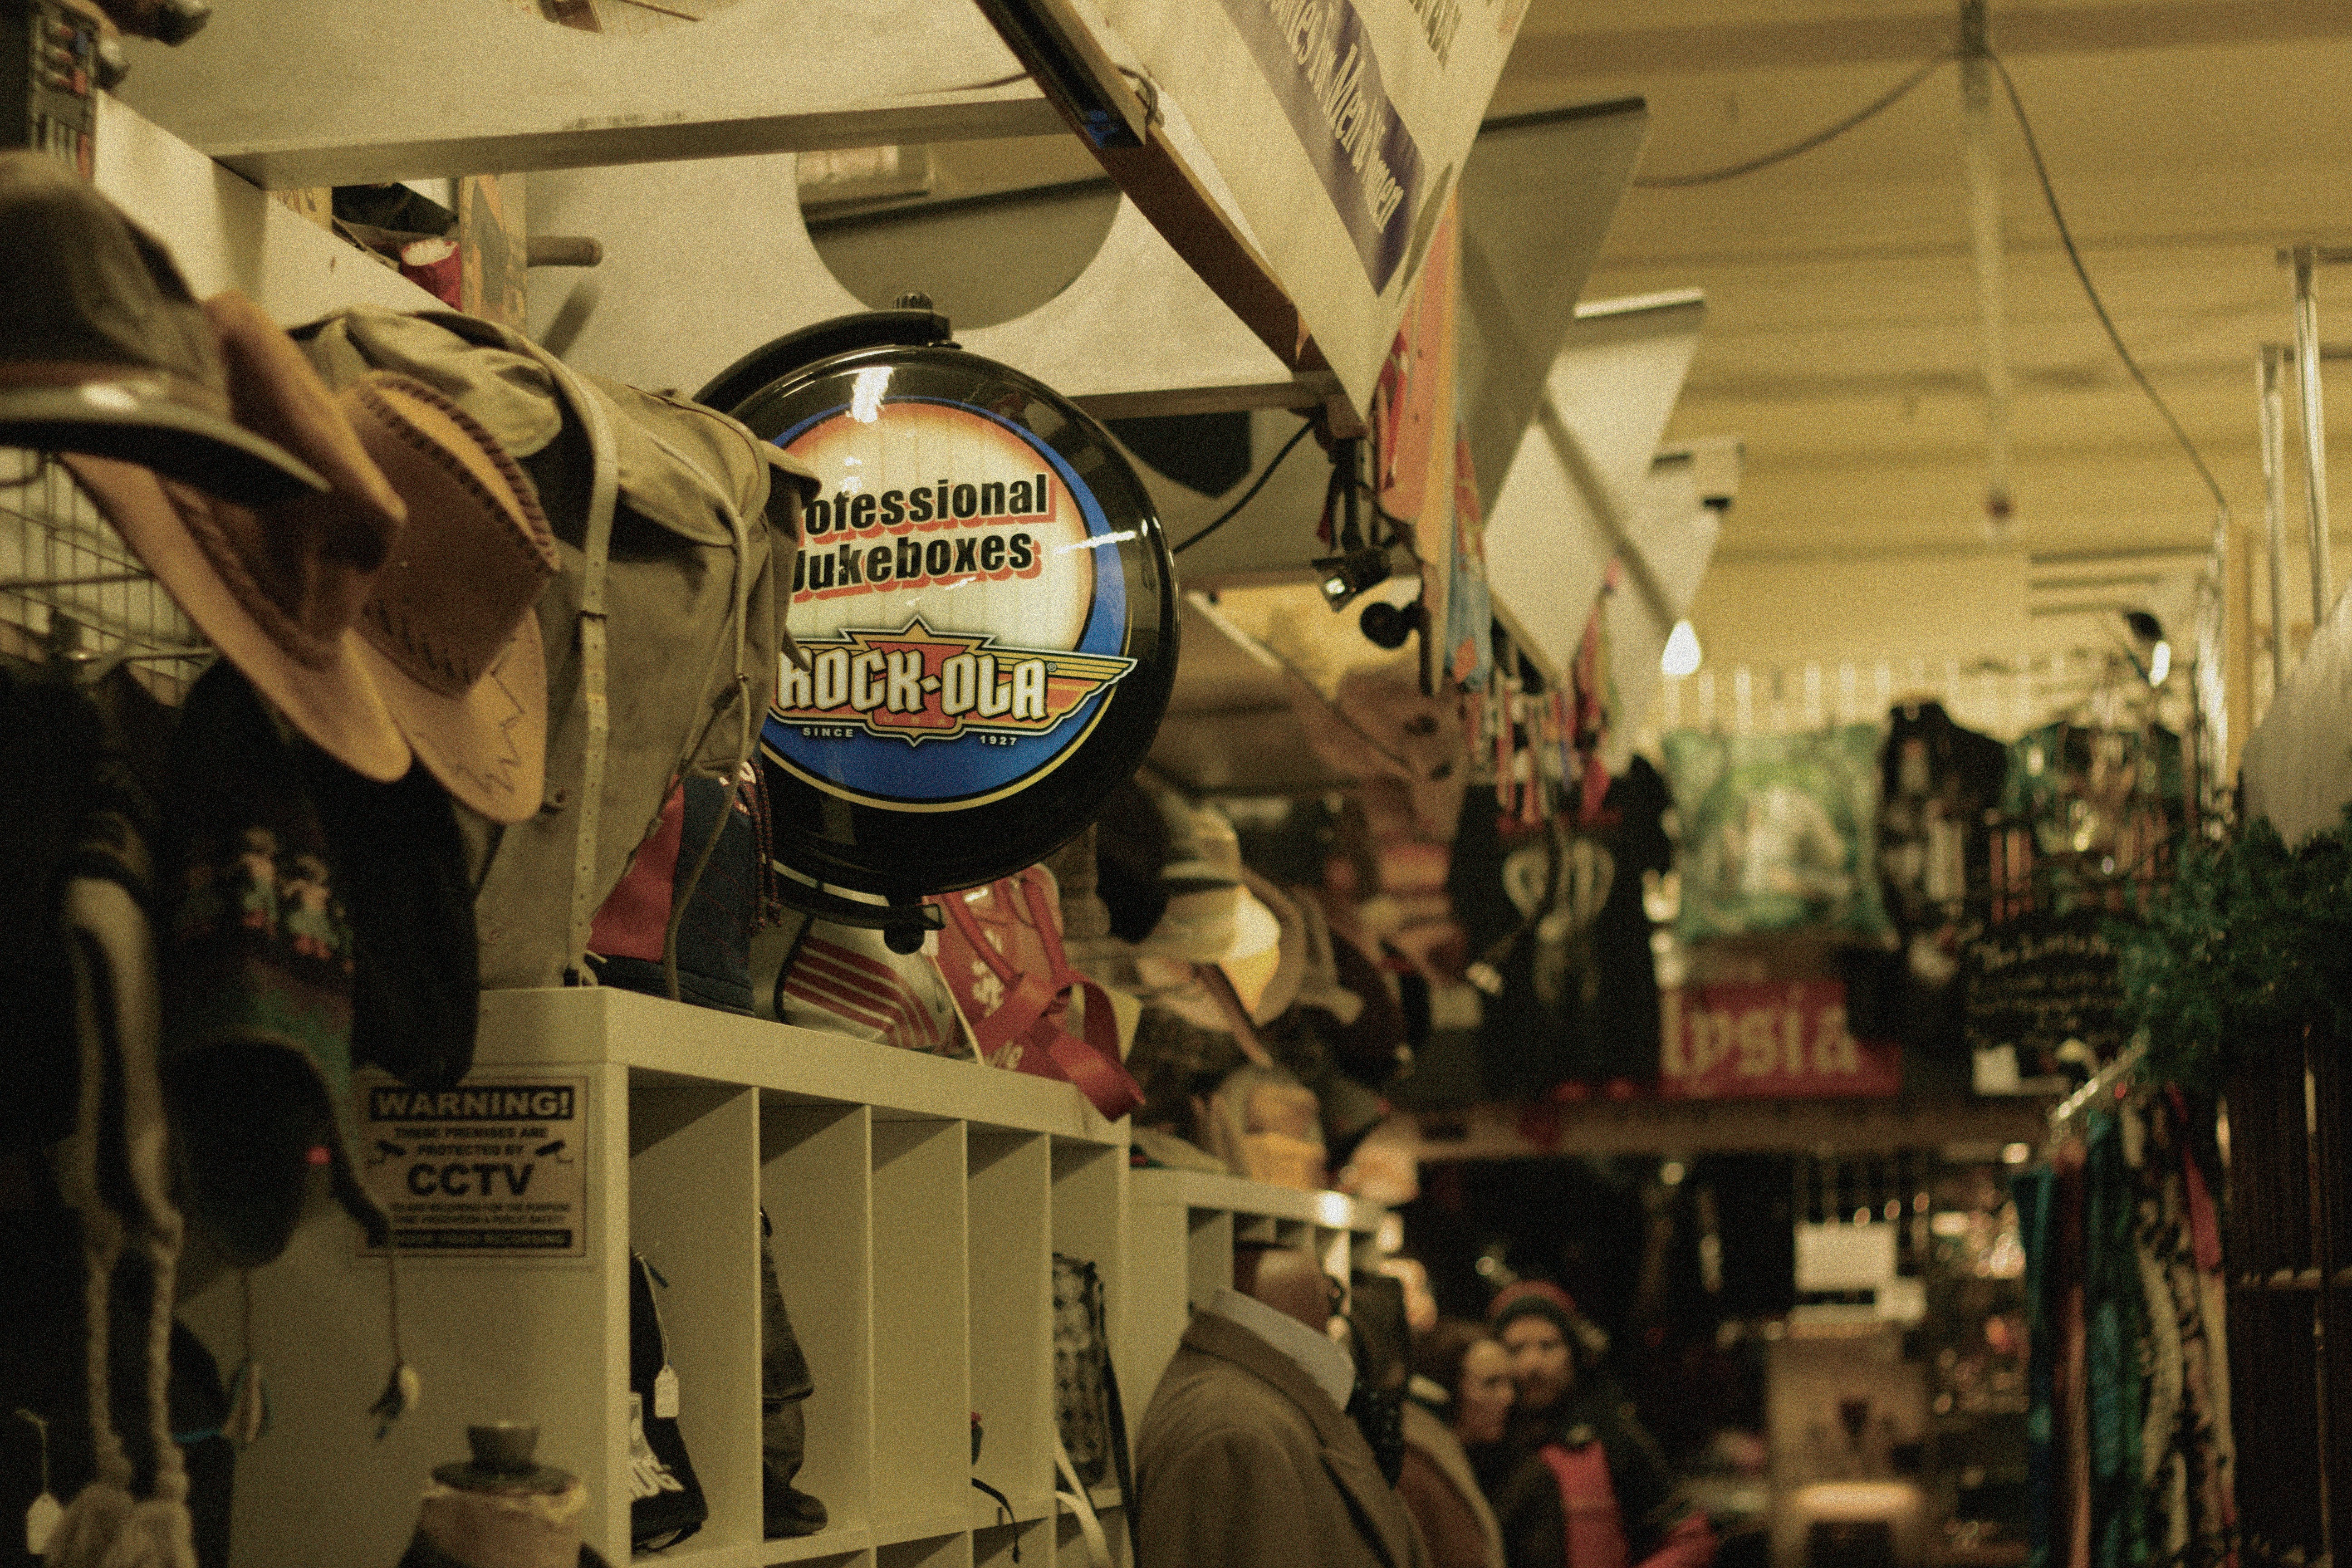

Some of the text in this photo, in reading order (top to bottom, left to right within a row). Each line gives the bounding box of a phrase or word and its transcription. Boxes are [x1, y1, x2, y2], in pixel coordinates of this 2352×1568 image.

[1322, 42, 1367, 153] Men
[802, 474, 1047, 534] ofessional
[792, 533, 1033, 593] Jukeboxes
[803, 727, 1018, 746] SINCE 1927
[376, 1091, 570, 1116] WARNING!
[520, 1127, 548, 1138] ARE
[418, 1145, 524, 1156] PROTECTED BY
[407, 1163, 534, 1196] CCTV
[485, 1234, 565, 1244] RECORDING
